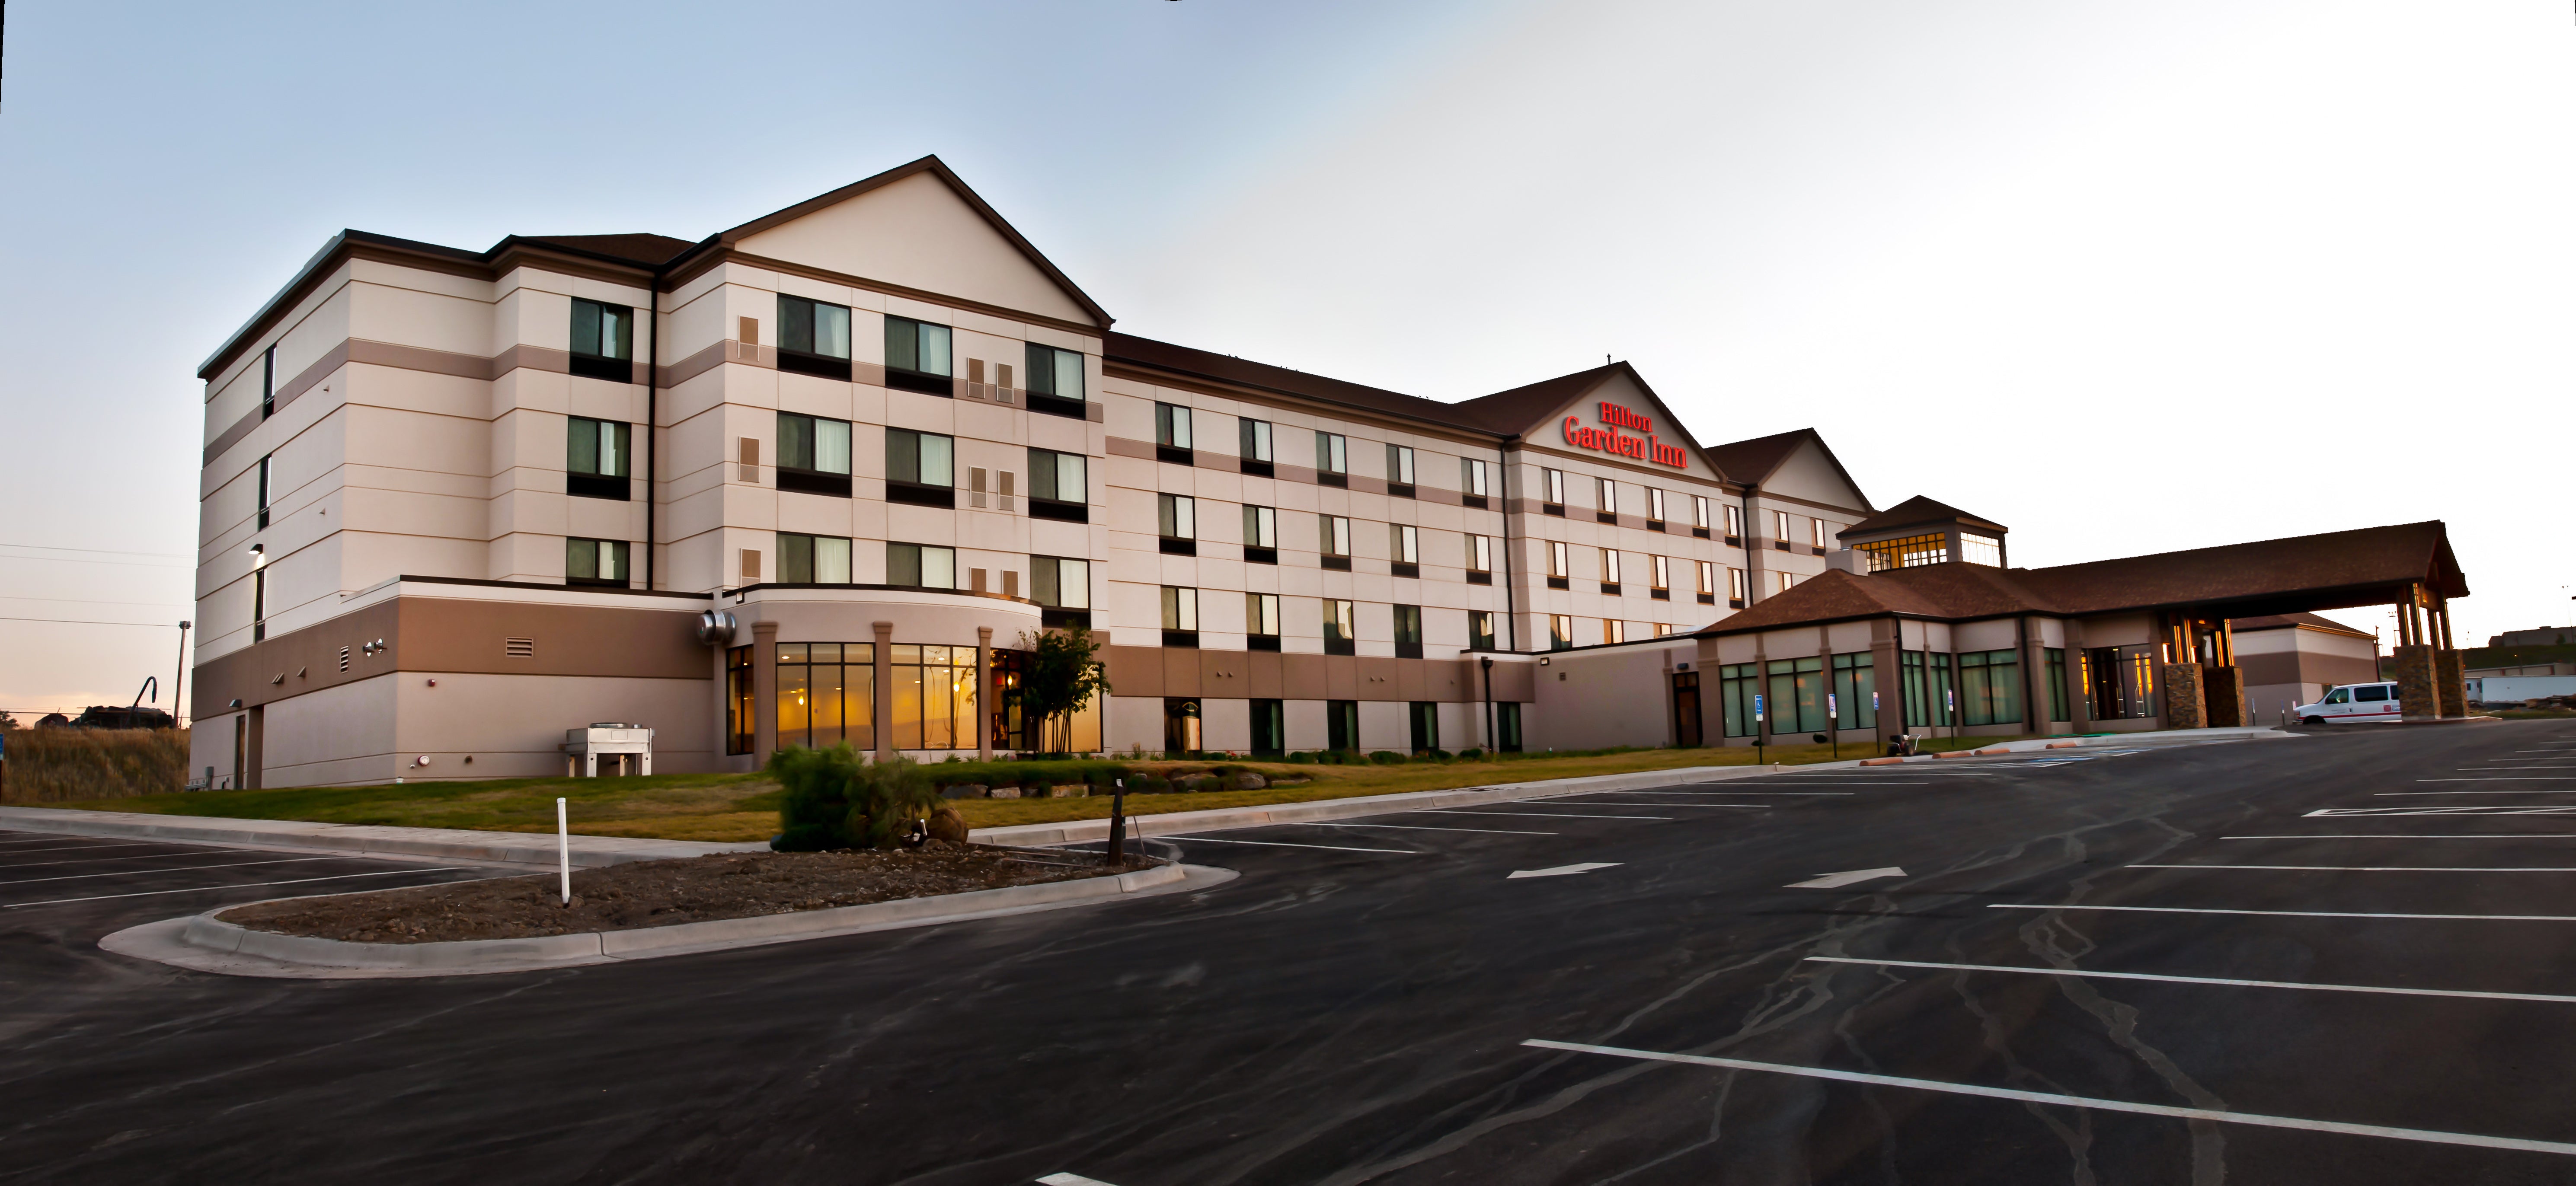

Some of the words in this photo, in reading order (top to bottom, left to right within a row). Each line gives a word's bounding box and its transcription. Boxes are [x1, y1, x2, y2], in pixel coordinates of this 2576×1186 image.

[1601, 401, 1653, 432] Hilton
[1565, 415, 1647, 459] Garden
[1650, 434, 1688, 469] Inn
